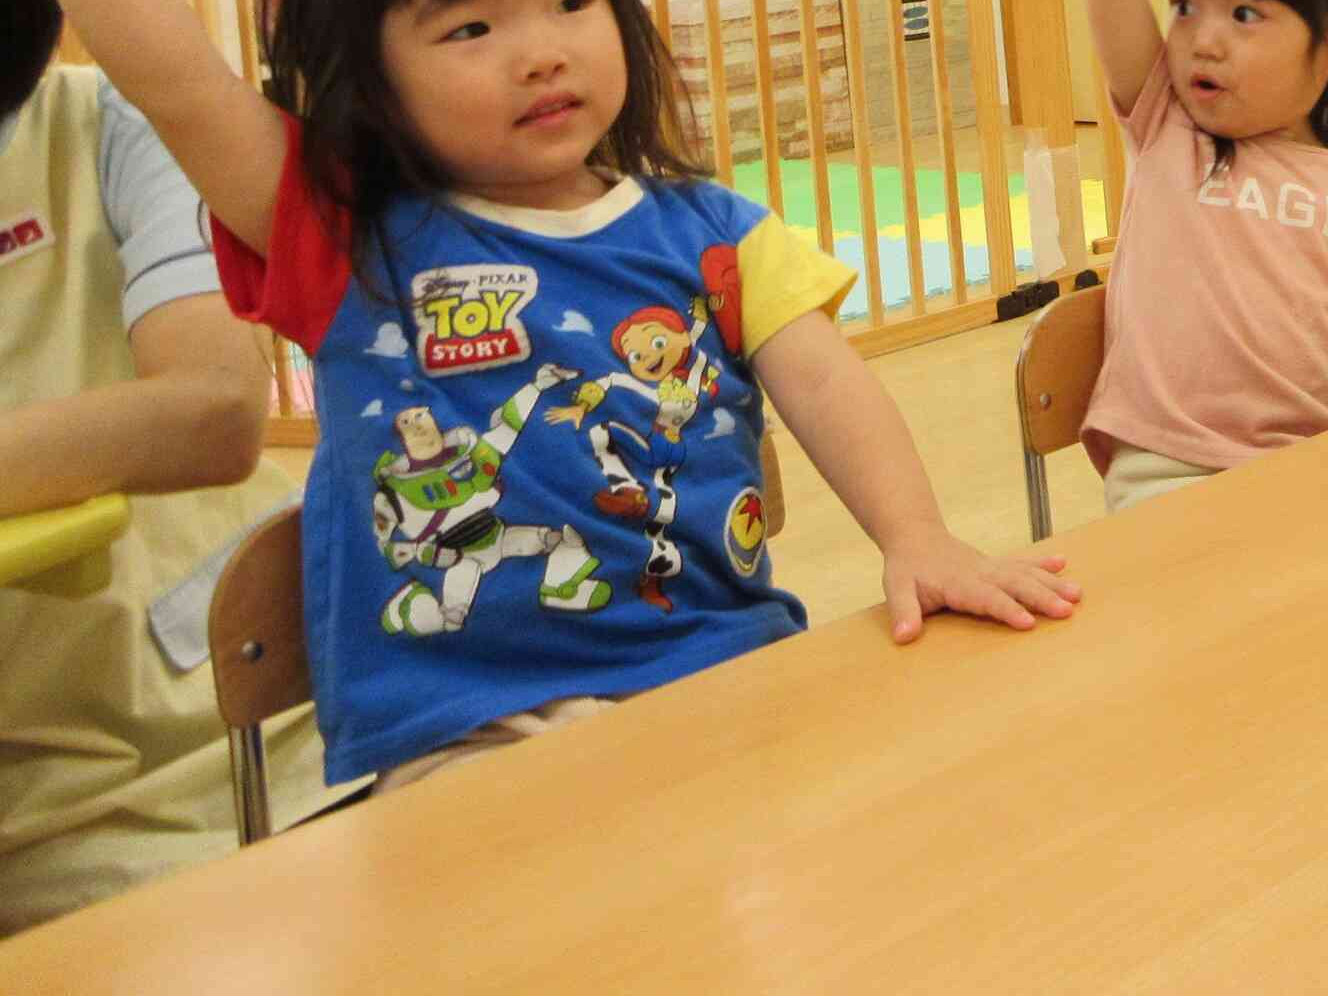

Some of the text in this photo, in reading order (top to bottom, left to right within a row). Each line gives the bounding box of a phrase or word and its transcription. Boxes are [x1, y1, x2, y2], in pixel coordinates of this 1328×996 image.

[480, 274, 528, 285] PIXAR
[425, 290, 526, 340] TOY
[433, 338, 508, 361] STORY
